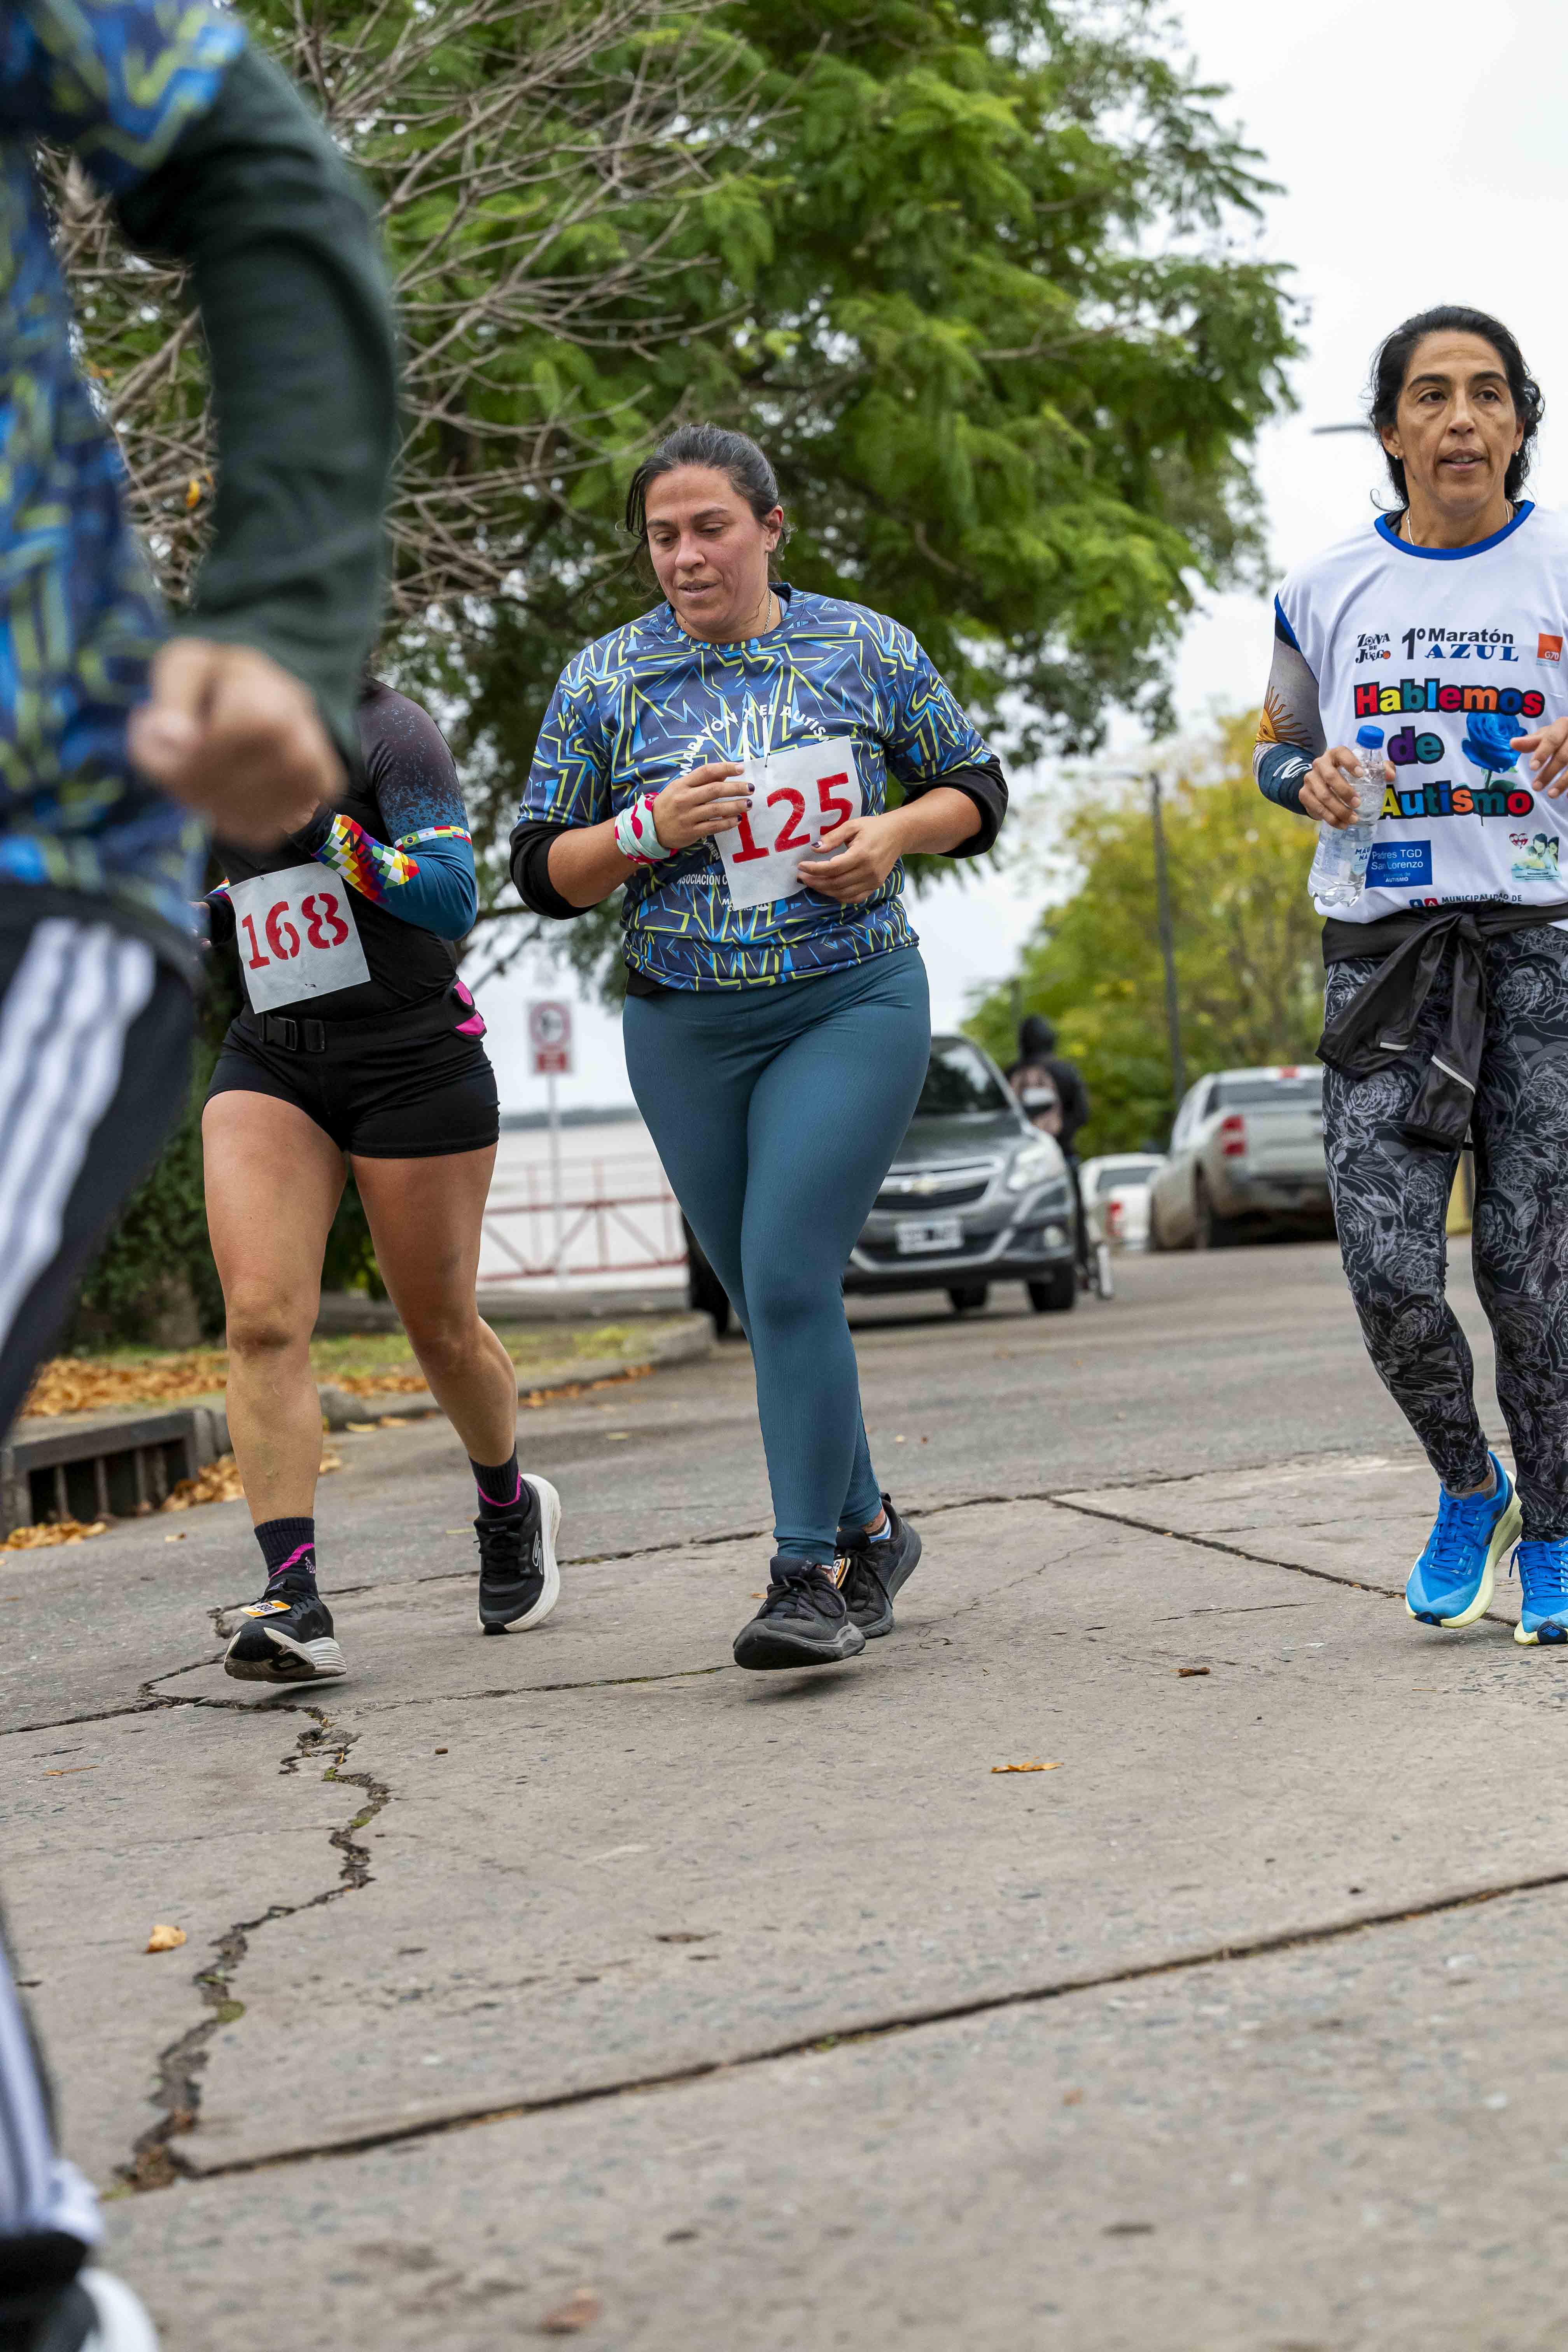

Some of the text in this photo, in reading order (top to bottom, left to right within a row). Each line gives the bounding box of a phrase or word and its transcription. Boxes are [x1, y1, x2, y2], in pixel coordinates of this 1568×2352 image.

[1428, 628, 1514, 644] Maratón
[1424, 644, 1519, 662] AZUL
[1545, 651, 1559, 660] G70
[1354, 678, 1545, 719] Hablemos
[680, 712, 738, 776] MARATÓN
[759, 704, 774, 716] EL
[1387, 725, 1445, 766] de
[1377, 780, 1535, 820] Autismo
[732, 772, 853, 863] 125
[1372, 849, 1422, 859] Padres TGD
[1371, 862, 1386, 870] San
[1387, 861, 1423, 870] Lorenzo
[677, 872, 720, 885] ASOCIACIÓN
[1442, 893, 1509, 903] MUNICIPALIDAD
[242, 892, 349, 970] 168
